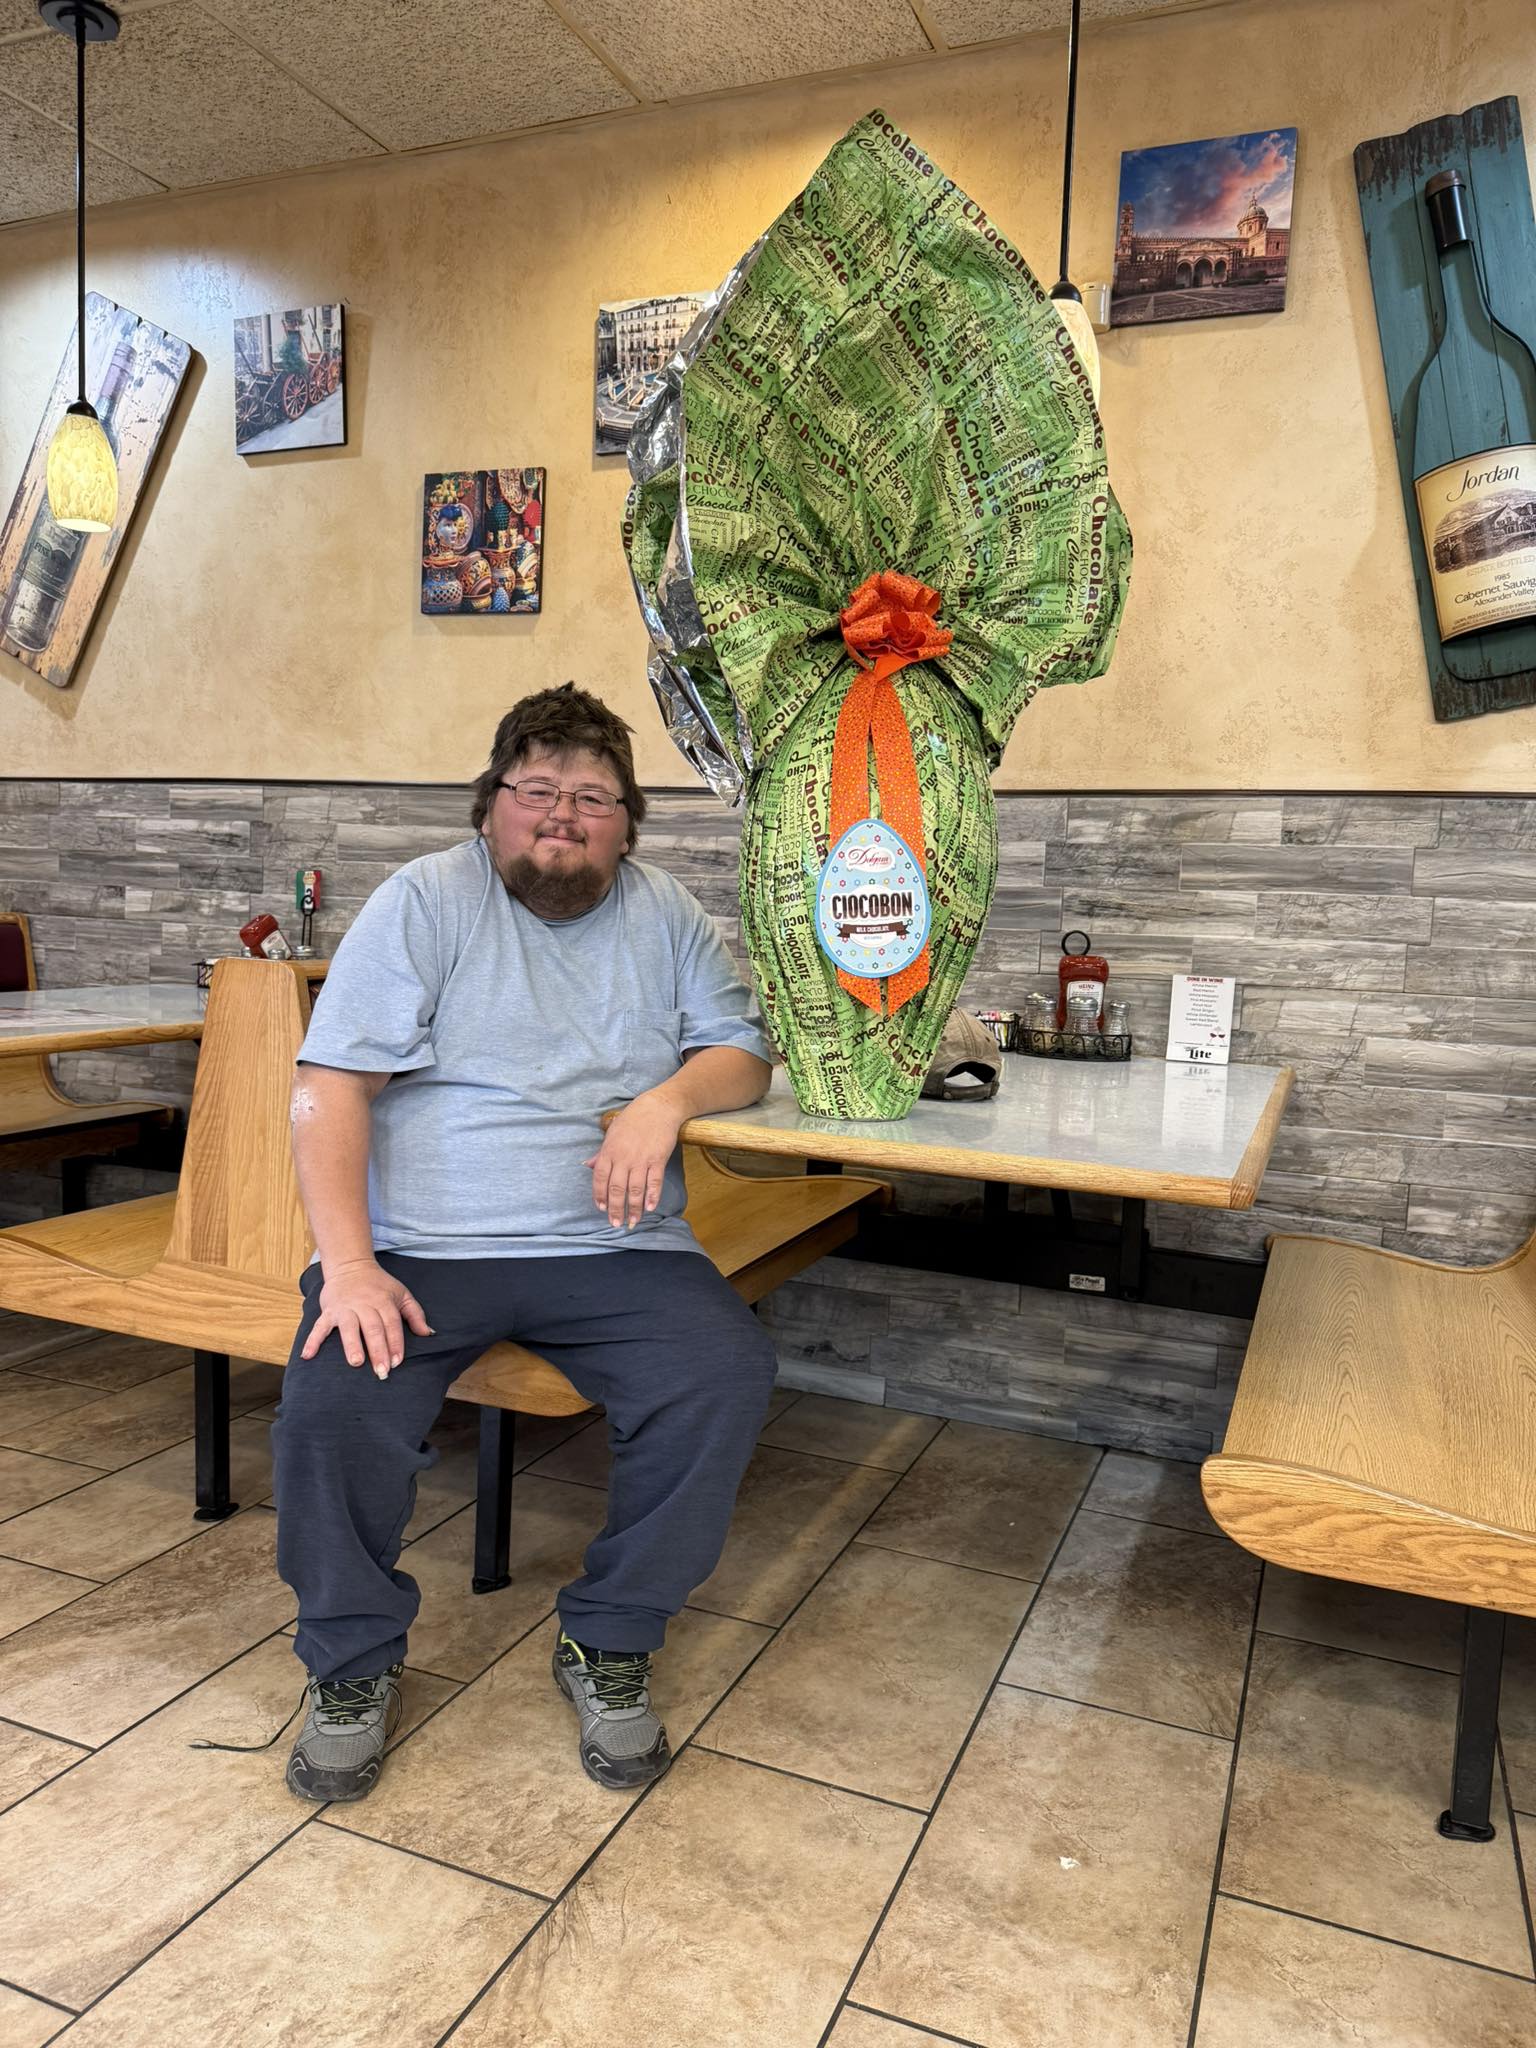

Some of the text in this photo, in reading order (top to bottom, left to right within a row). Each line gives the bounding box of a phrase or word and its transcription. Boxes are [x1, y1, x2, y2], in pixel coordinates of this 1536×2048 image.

[962, 200, 1046, 304] Chocolate
[1446, 464, 1521, 502] Jordan
[1083, 495, 1108, 625] Chocolate
[1066, 538, 1081, 615] Chocolate
[1494, 572, 1511, 582] 1985
[1454, 585, 1502, 604] Cabernet
[1473, 587, 1536, 608] Alexander Valley
[831, 891, 914, 920] CIOCOBON
[1189, 1050, 1212, 1060] Lite
